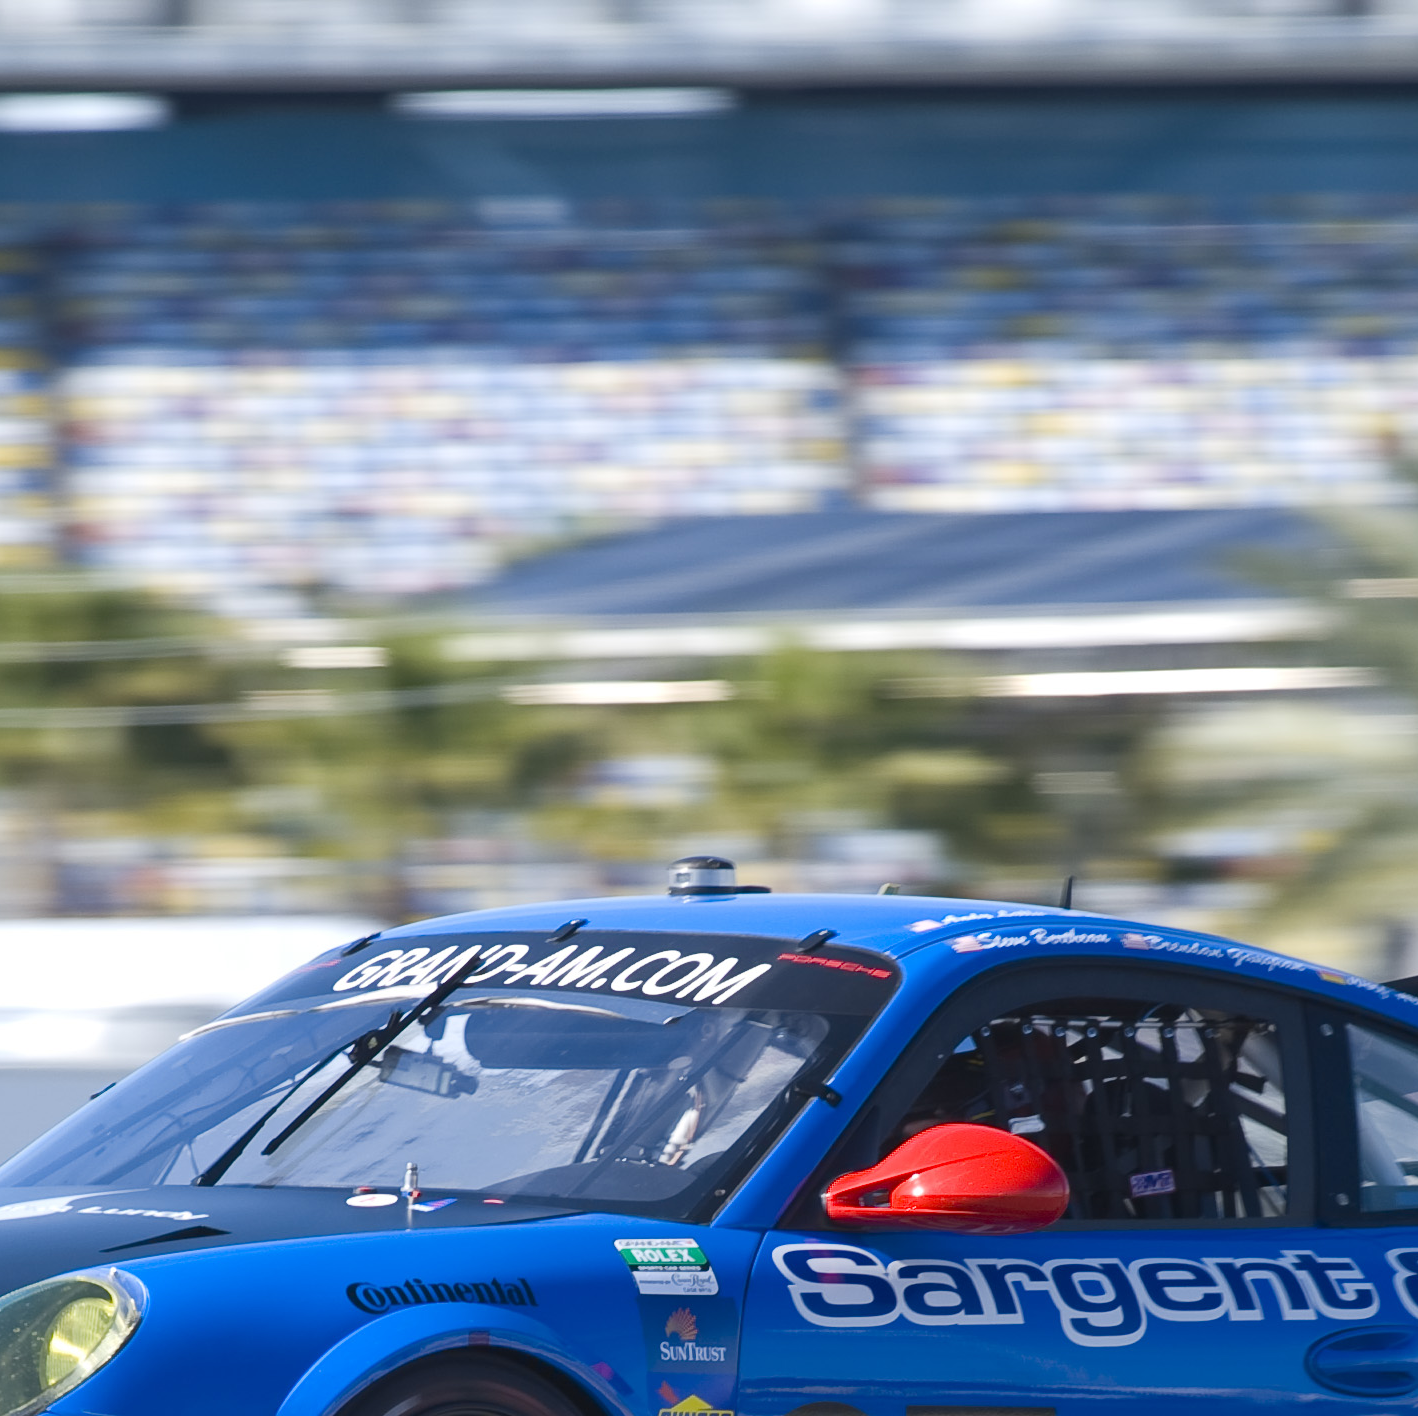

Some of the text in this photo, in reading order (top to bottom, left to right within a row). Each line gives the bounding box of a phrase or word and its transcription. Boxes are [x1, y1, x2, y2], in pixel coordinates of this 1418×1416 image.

[332, 944, 772, 1005] GRAND-AM.COM
[630, 1248, 696, 1263] ROLEX
[345, 1276, 538, 1315] Continental
[772, 1243, 1381, 1347] Sargent
